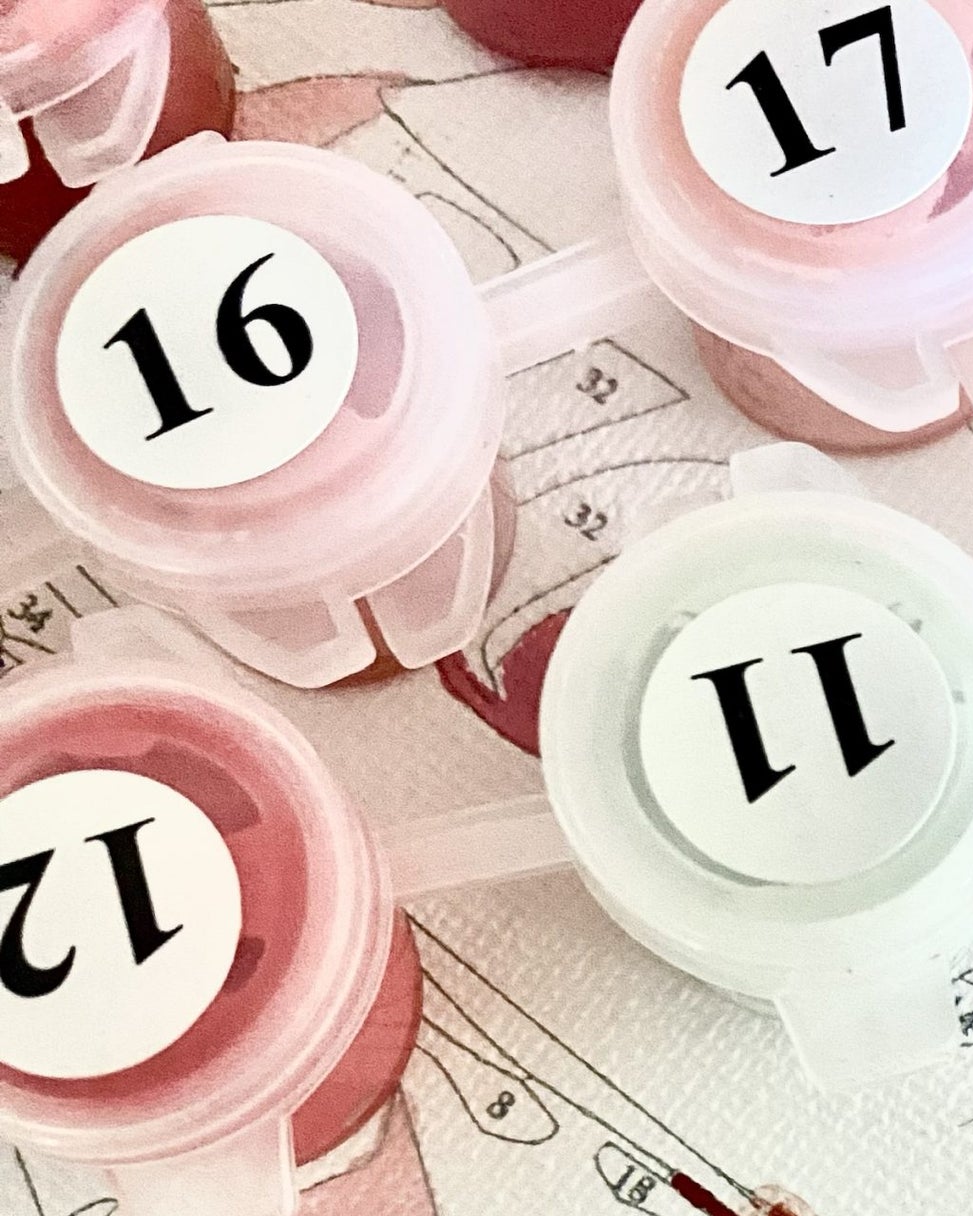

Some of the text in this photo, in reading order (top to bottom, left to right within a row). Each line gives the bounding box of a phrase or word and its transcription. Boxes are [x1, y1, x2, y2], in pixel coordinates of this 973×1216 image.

[726, 5, 906, 177] 17
[104, 253, 313, 441] 16
[576, 367, 618, 405] 32
[564, 503, 608, 541] 32
[691, 633, 895, 803] 11
[0, 818, 183, 998] 12
[486, 1091, 515, 1119] 8
[616, 1165, 657, 1205] 18
